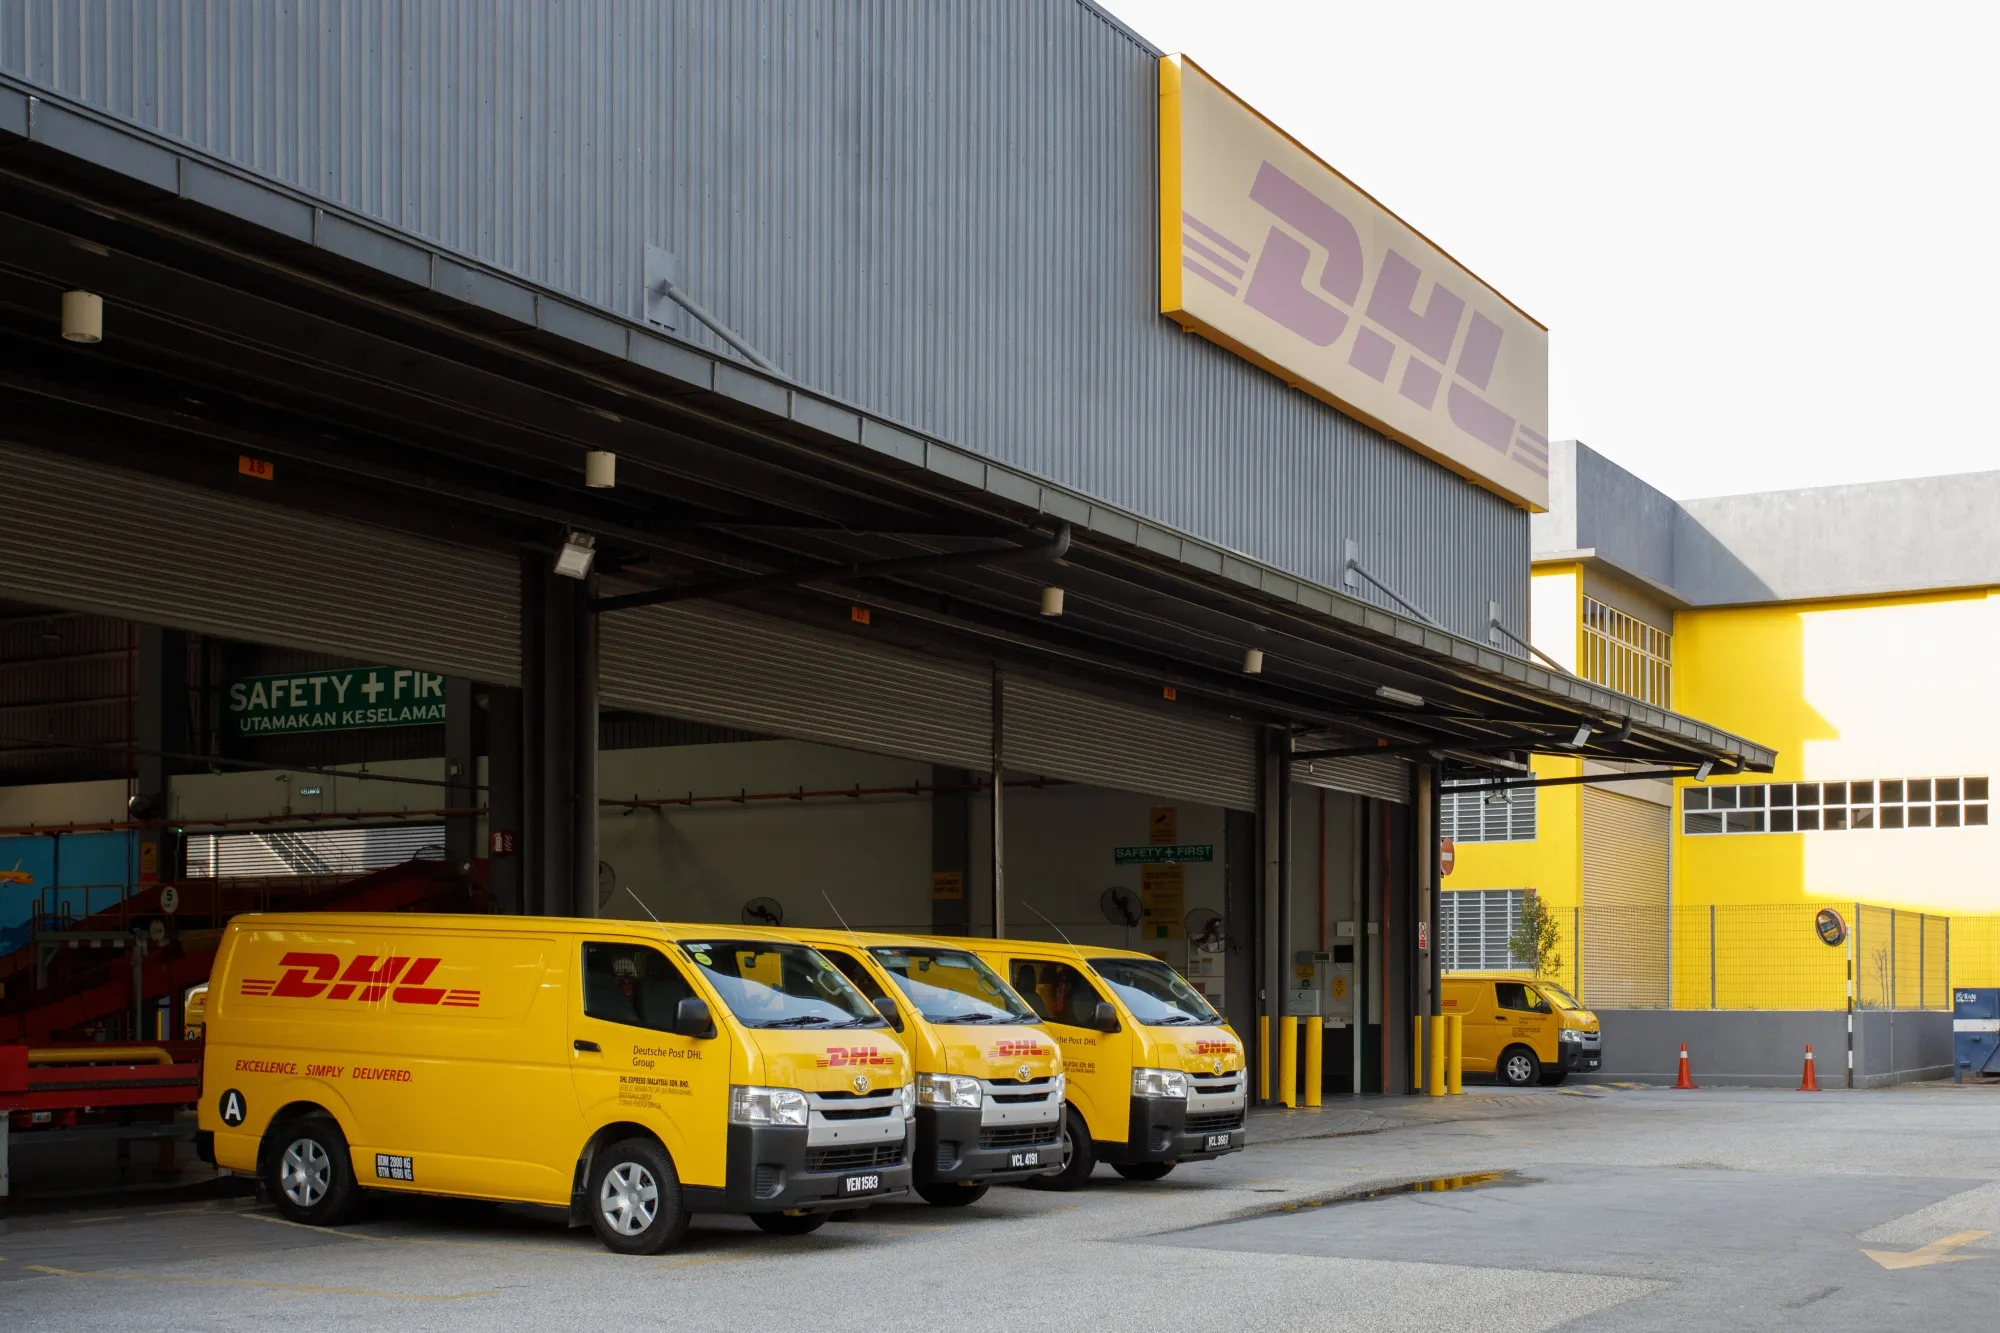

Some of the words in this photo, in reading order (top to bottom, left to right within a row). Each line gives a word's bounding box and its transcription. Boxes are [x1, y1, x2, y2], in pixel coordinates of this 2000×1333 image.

[1243, 160, 1516, 455] DHL
[229, 674, 353, 712] SAFETY
[393, 670, 446, 700] FIR
[240, 711, 337, 732] UTAMAKAN
[1116, 847, 1162, 858] SAFETY
[1177, 846, 1212, 856] FIRST
[167, 890, 173, 901] 5
[271, 952, 447, 1005] DHL
[996, 1040, 1042, 1056] DHL
[1069, 1037, 1082, 1045] Post
[1084, 1038, 1096, 1046] DHL
[1196, 1040, 1230, 1054] DHL
[633, 1046, 667, 1057] Deutsche
[668, 1048, 684, 1058] Post
[687, 1050, 703, 1060] DHL
[827, 1047, 885, 1066] DHL
[632, 1057, 655, 1069] Group
[235, 1060, 298, 1075] EXCELLENCE.
[305, 1064, 344, 1078] SIMPLY
[352, 1067, 413, 1082] DELIVERED.
[628, 1076, 646, 1084] EXPRESS
[225, 1093, 242, 1121] A
[377, 1155, 389, 1166] BDM
[403, 1158, 411, 1169] KG
[1012, 1154, 1024, 1167] VCL
[847, 1177, 861, 1192] VEN
[862, 1175, 878, 1190] 1583
